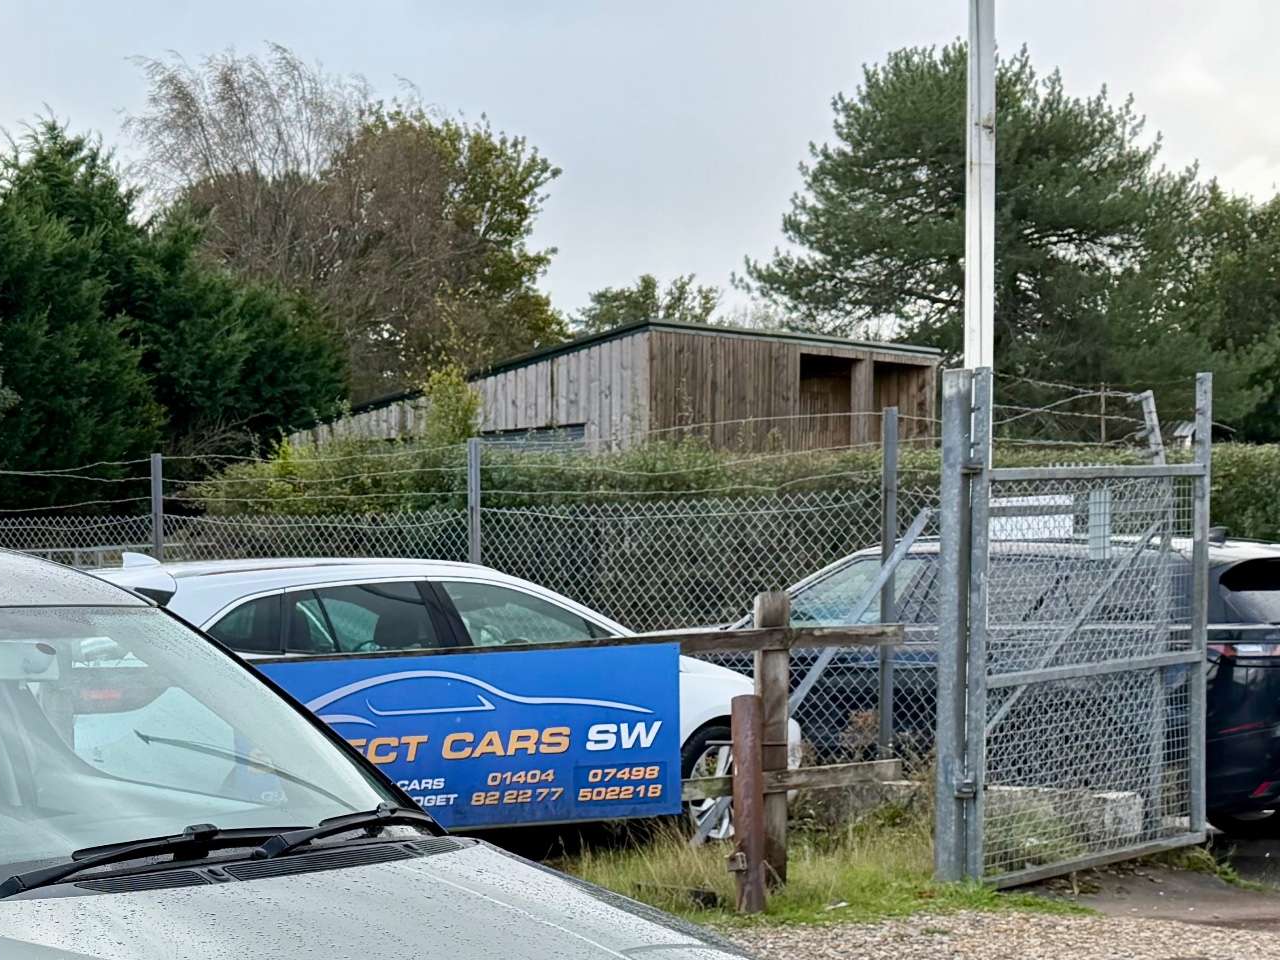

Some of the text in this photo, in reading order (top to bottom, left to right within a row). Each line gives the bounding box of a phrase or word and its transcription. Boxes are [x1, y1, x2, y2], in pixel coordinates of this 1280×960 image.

[441, 726, 571, 760] CARS
[585, 720, 663, 751] SW
[487, 768, 555, 786] 01404
[587, 765, 660, 783] 07498
[397, 778, 445, 791] CARS
[577, 783, 663, 801] 502218
